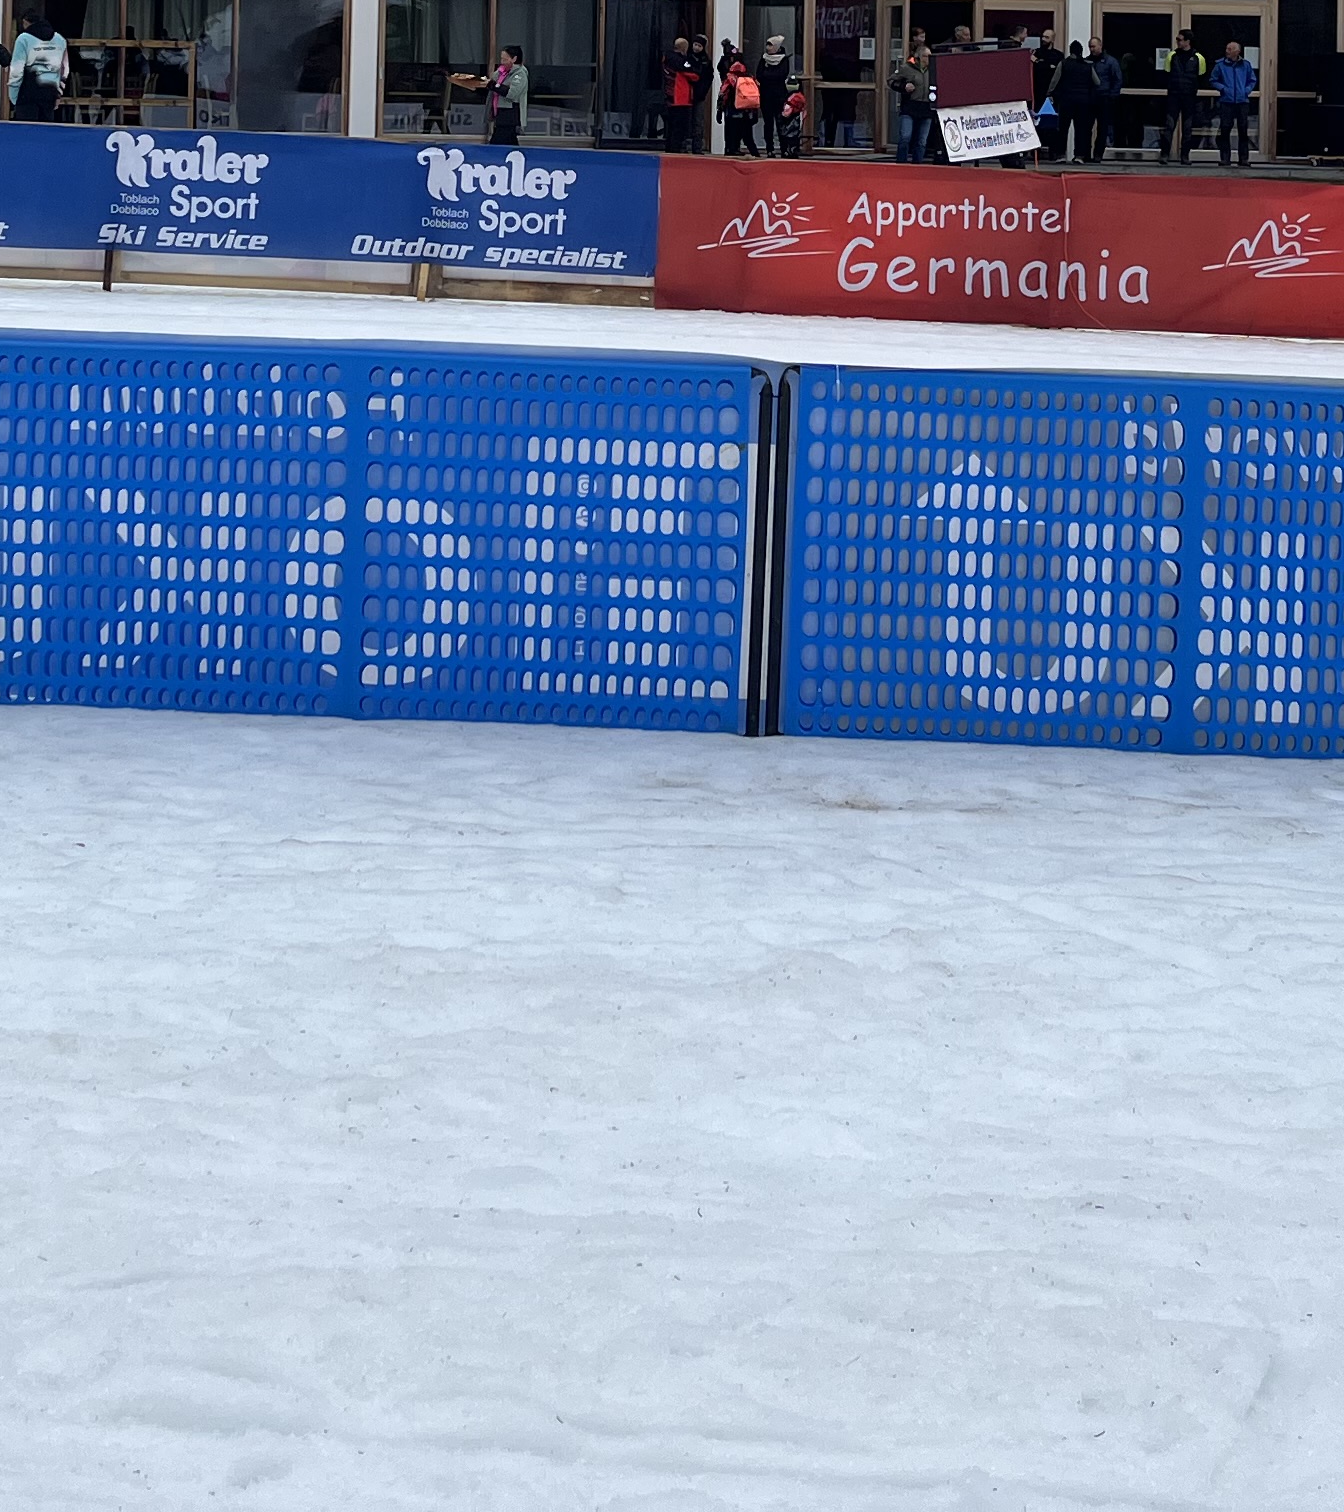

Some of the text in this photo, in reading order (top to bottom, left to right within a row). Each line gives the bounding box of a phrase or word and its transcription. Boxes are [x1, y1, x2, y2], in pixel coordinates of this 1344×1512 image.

[106, 130, 270, 188] Kraler
[416, 147, 577, 202] Kraler
[110, 204, 159, 216] Dobbiaco
[120, 193, 160, 204] Toblach
[169, 184, 259, 223] Sport
[431, 206, 469, 219] Toblach
[847, 191, 1071, 238] Apparthotel
[97, 223, 269, 251] Ski Service
[421, 217, 468, 230] Dobbiaco
[478, 199, 567, 238] Sport
[350, 234, 628, 270] Outdoor specialist
[836, 236, 1150, 305] Germania
